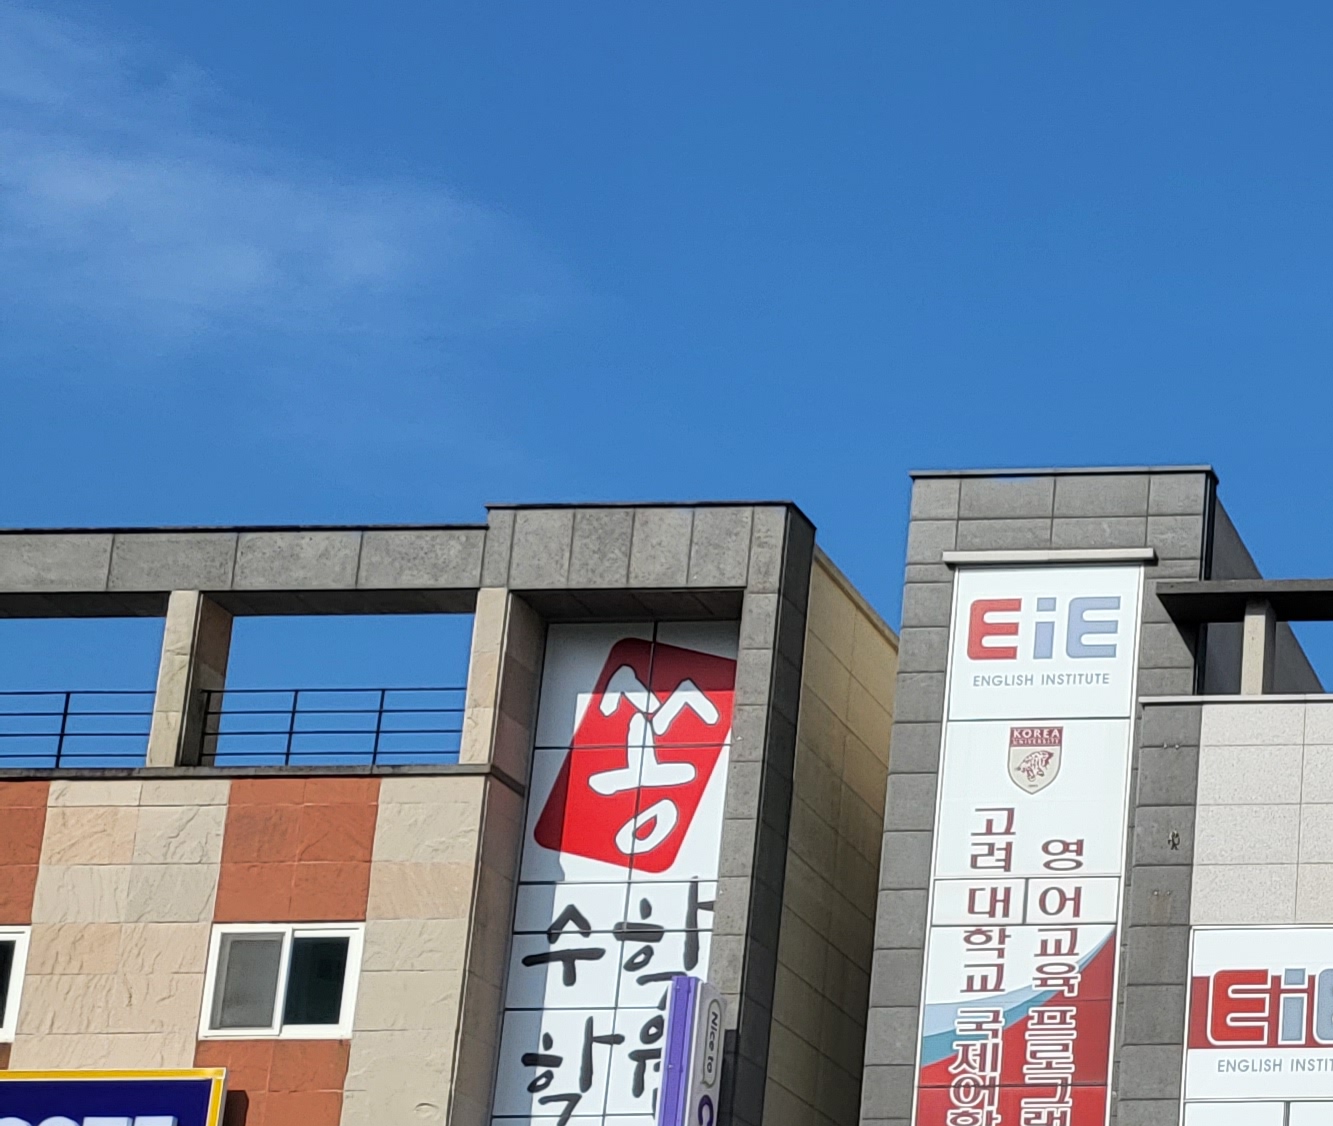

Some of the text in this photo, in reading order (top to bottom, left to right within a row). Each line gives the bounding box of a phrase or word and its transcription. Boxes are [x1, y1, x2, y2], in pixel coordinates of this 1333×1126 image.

[967, 596, 1122, 661] EiE
[972, 673, 1110, 687] ENGLISH INSTITUTE
[1013, 728, 1061, 739] KOREA
[1217, 1058, 1282, 1074] ENGLISH
